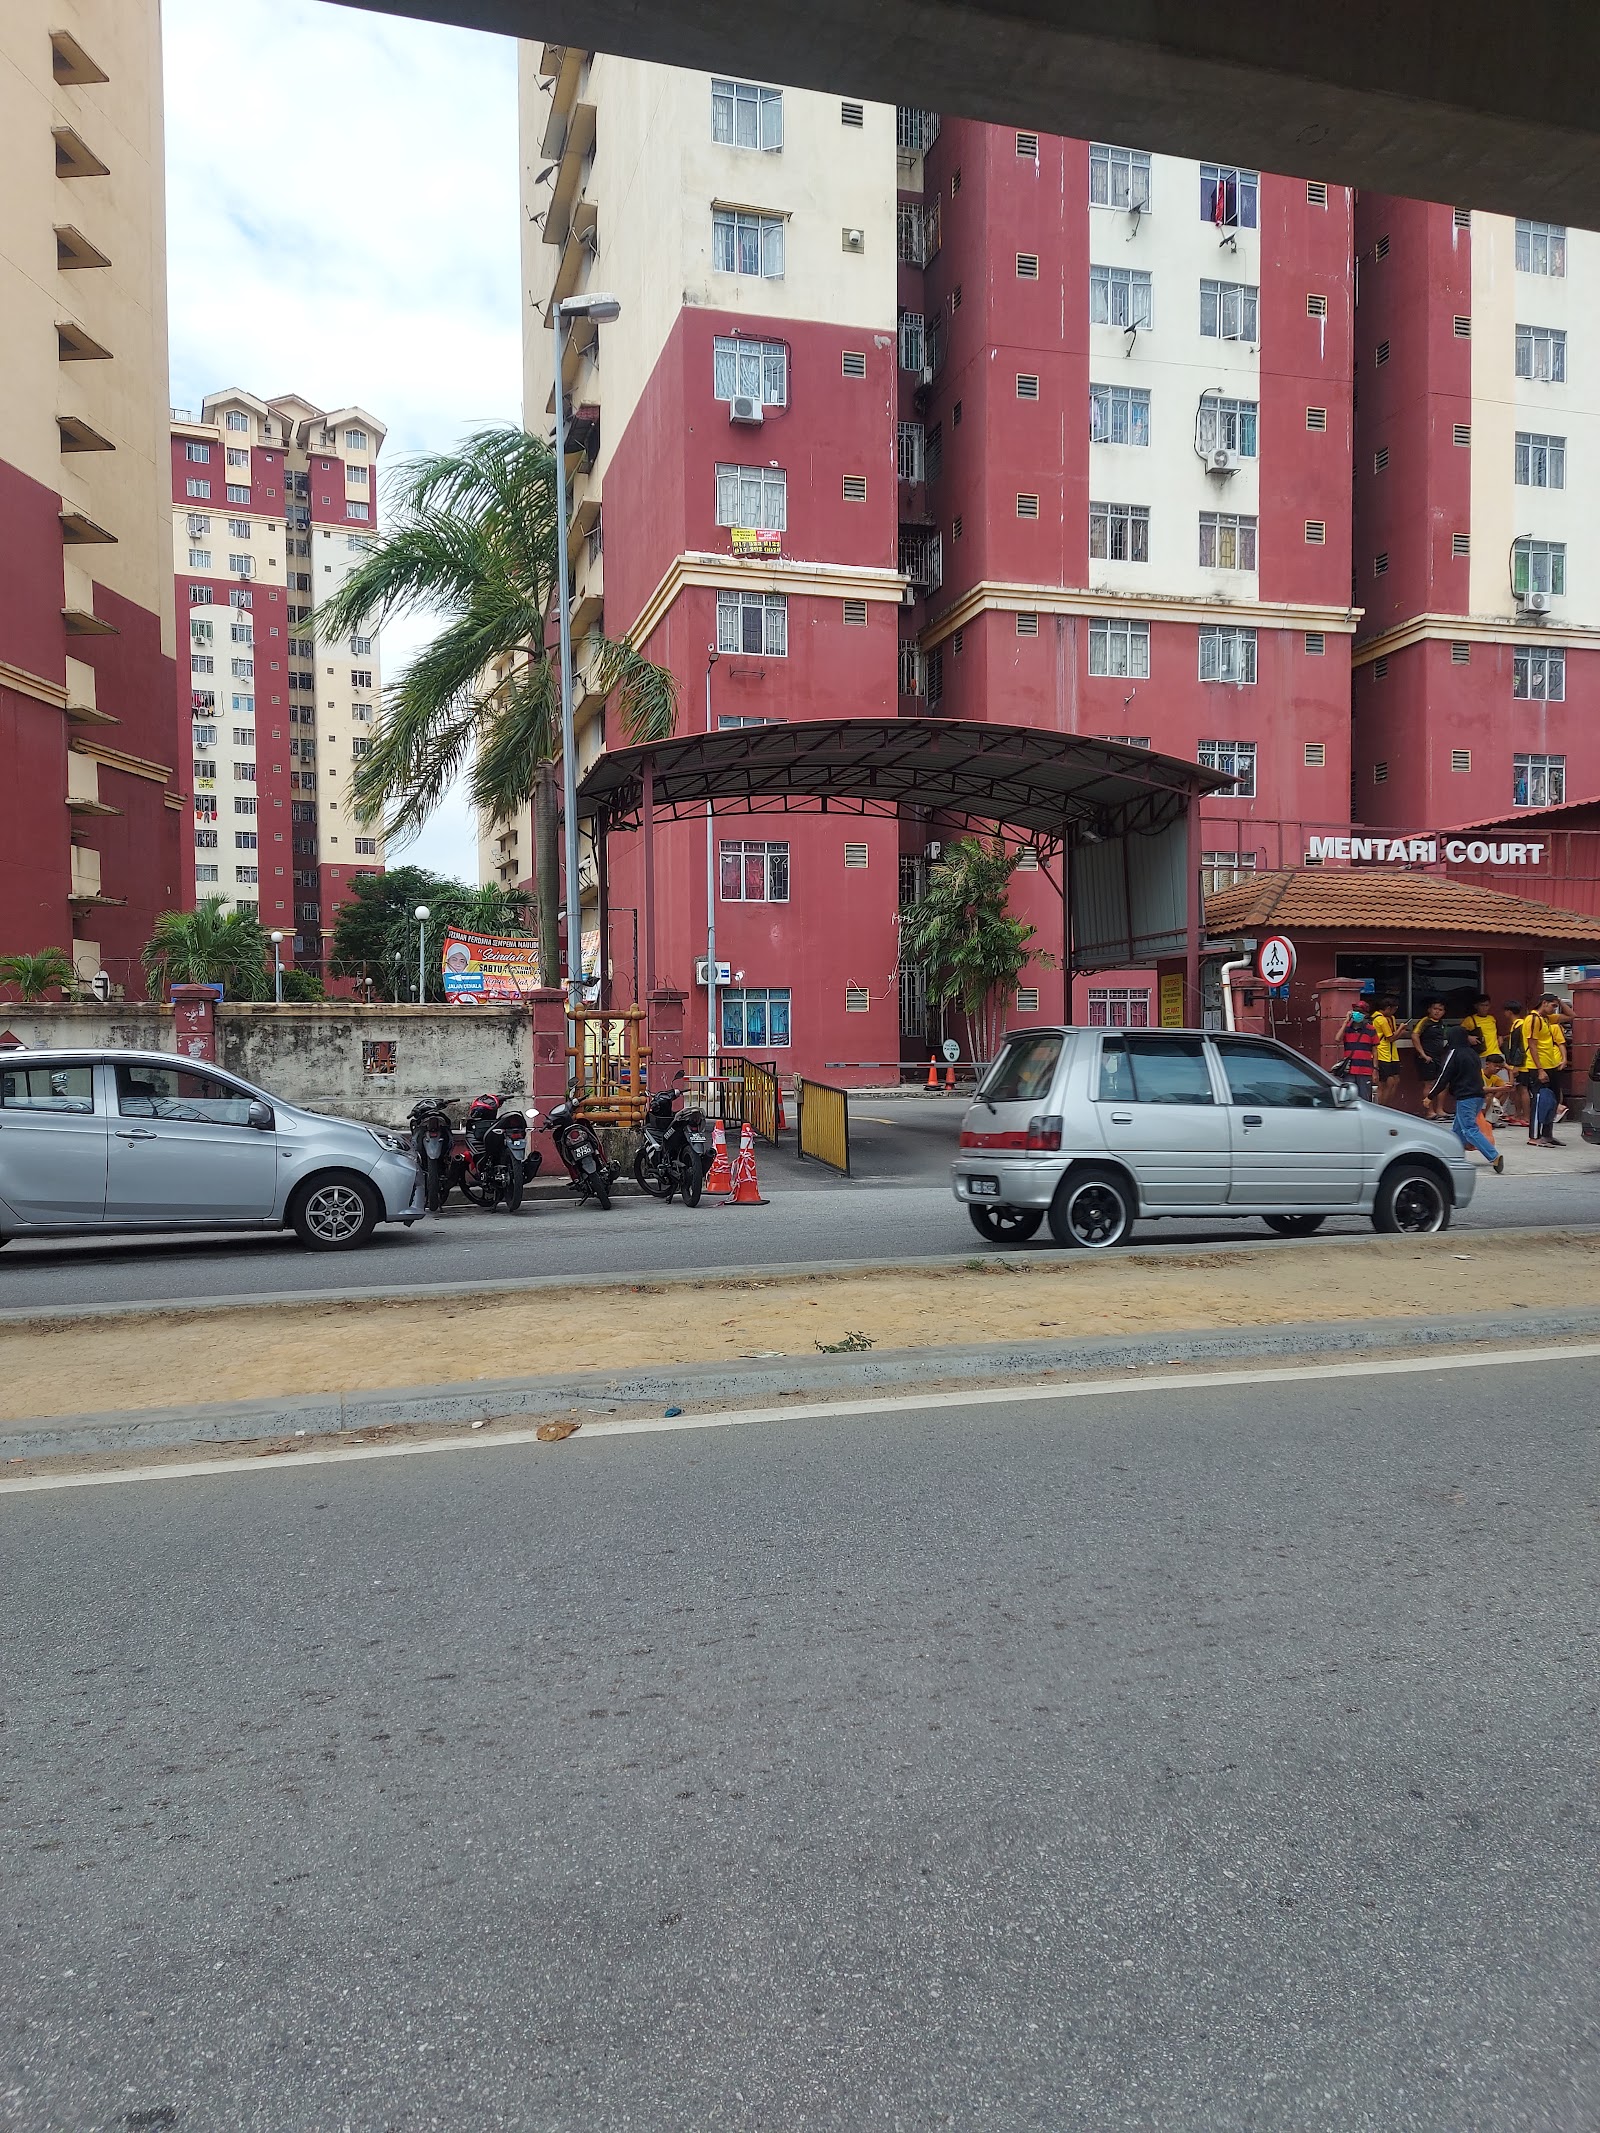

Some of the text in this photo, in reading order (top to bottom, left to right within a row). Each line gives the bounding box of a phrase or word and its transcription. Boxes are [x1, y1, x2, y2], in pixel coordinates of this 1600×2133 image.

[1309, 836, 1545, 865] MENTARI COURT
[479, 963, 503, 974] SABTU
